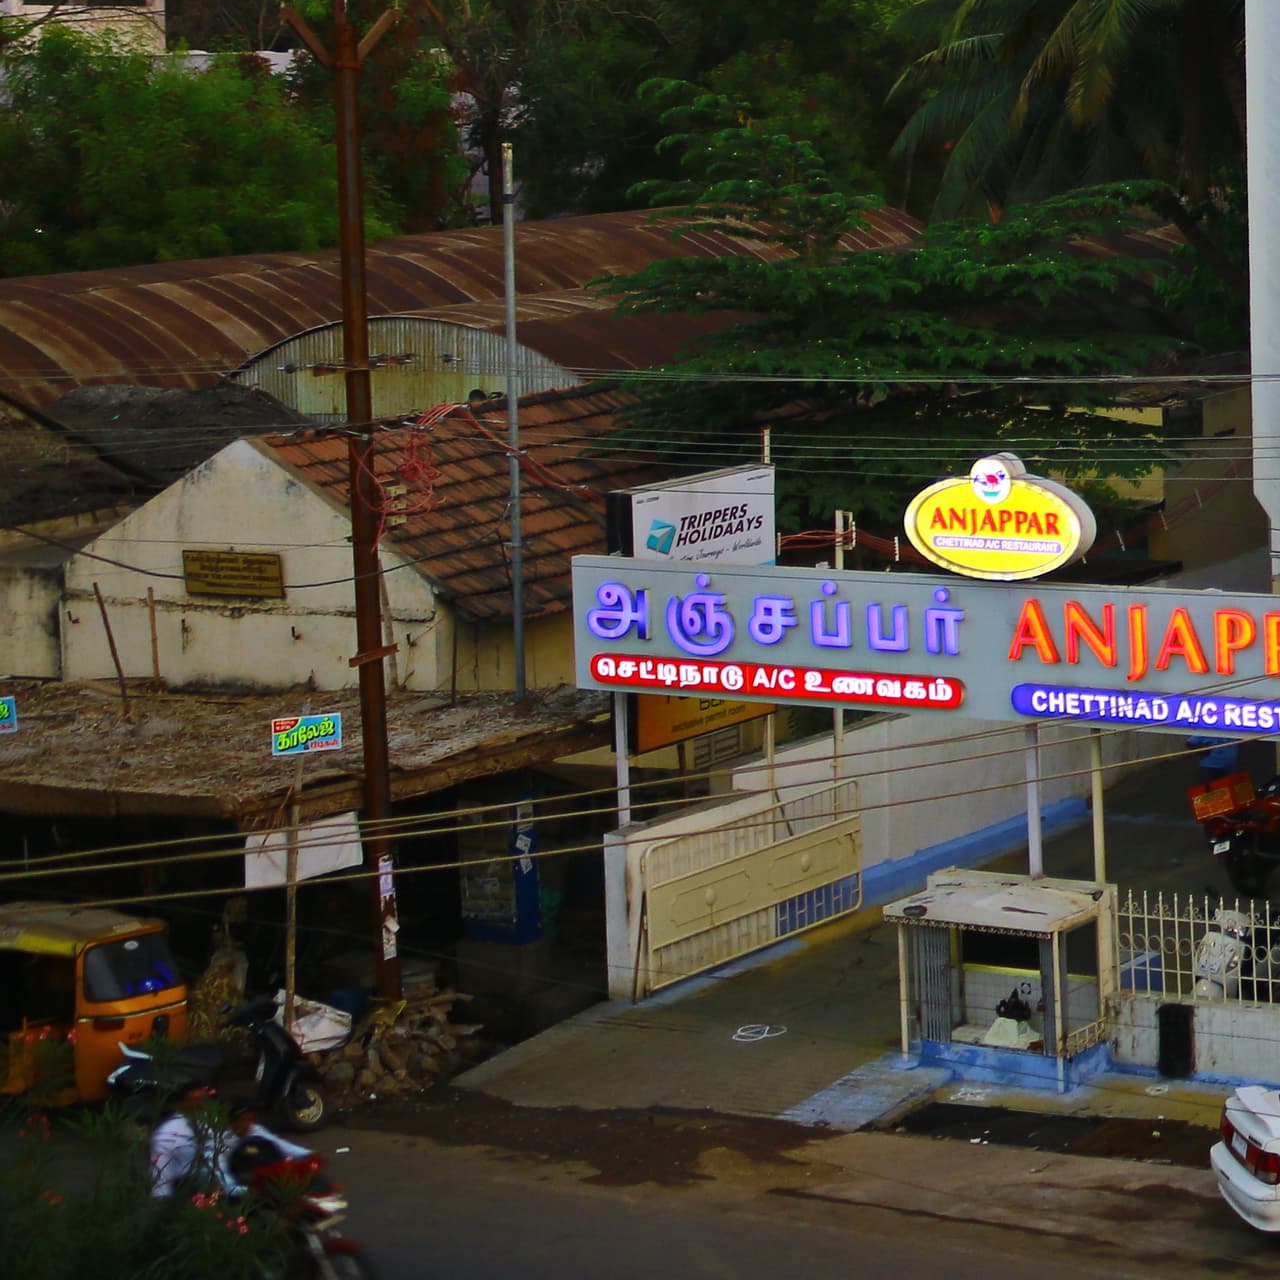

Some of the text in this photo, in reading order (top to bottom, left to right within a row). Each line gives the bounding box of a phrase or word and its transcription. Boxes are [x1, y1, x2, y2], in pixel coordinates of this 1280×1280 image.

[676, 516, 763, 547] HOLIDAAYS
[680, 504, 748, 532] TRIPPERS
[930, 507, 1061, 536] ANJAPPAR
[936, 536, 1058, 552] CHETTINAD A/C RESTAURANT
[587, 573, 965, 656] அஞ்சப்பர்
[597, 657, 953, 701] செட்டிநாடு A/C உணவகம்
[1031, 691, 1169, 722] CHETTINAD
[1176, 701, 1218, 726] A/C
[277, 717, 334, 750] காலேஜ்
